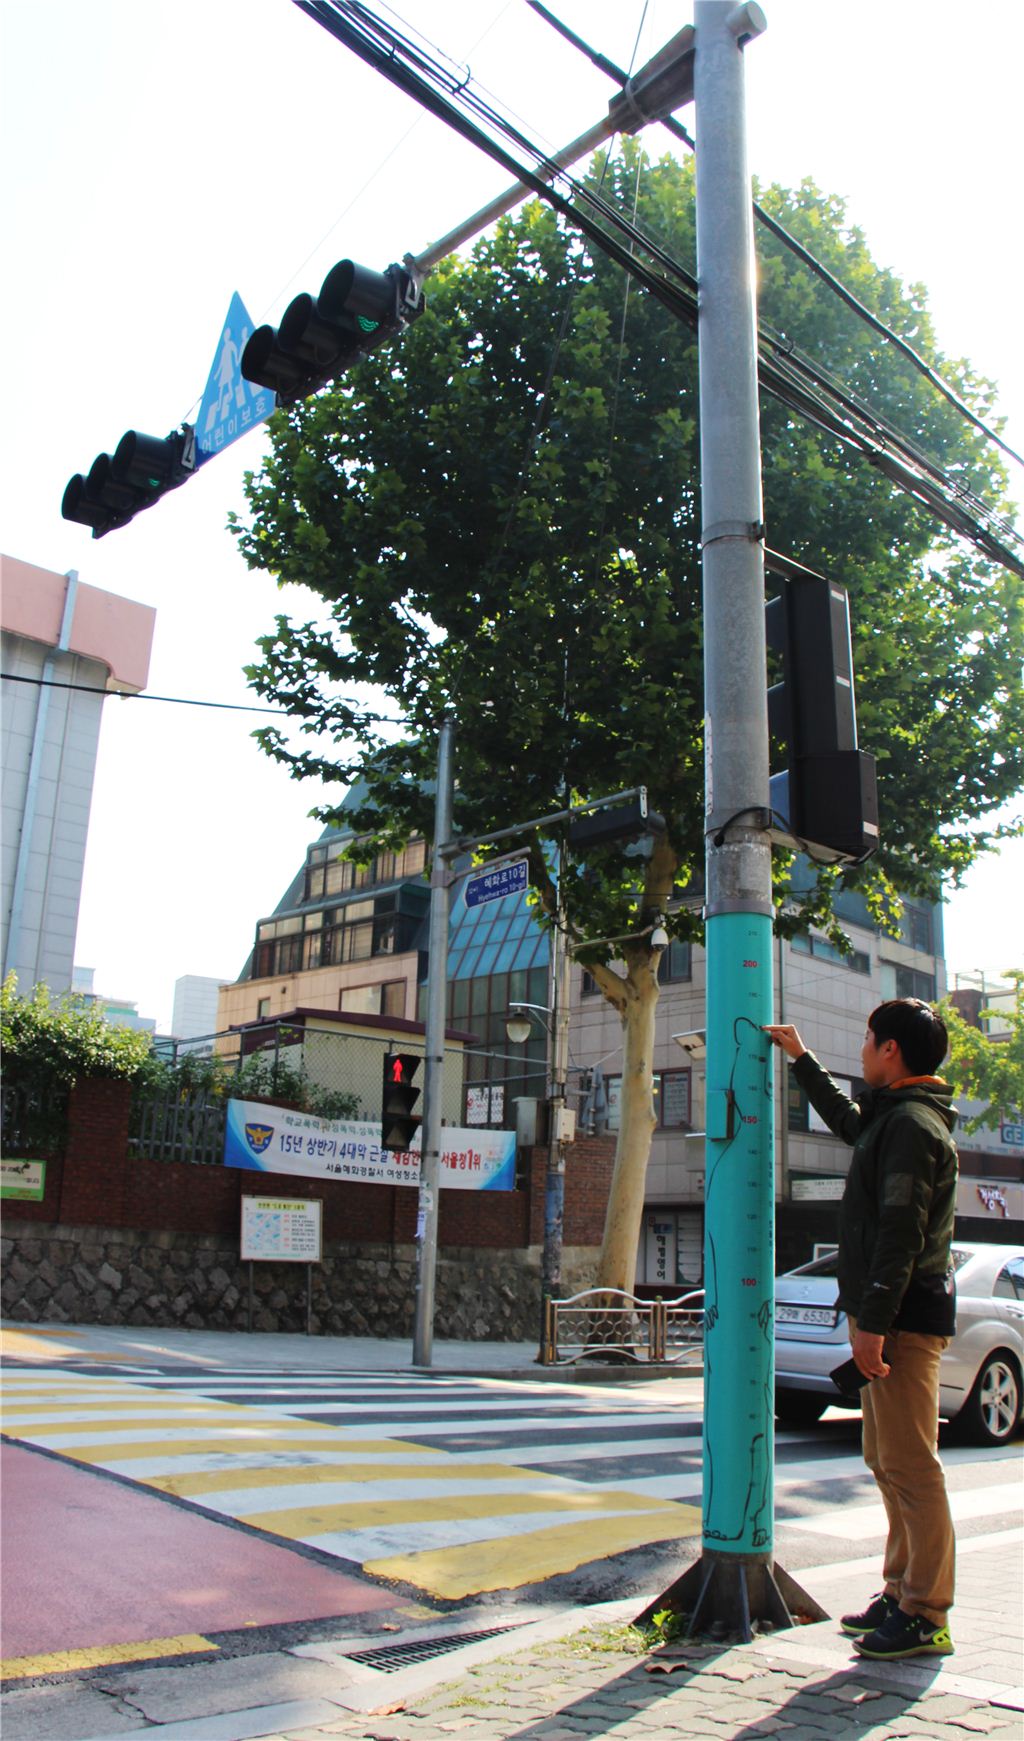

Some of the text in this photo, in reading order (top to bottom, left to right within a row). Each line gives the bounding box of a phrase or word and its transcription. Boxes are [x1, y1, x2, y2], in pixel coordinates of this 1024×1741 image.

[202, 396, 267, 455] 어린이보호
[484, 864, 526, 888] 혜화로10길
[742, 959, 758, 969] 200
[742, 1115, 758, 1124] 150
[280, 1134, 303, 1154] 15년
[306, 1138, 337, 1158] 상반기
[339, 1142, 367, 1161] 4대악
[325, 1163, 422, 1181] 서울혜화경찰서 여성청소
[741, 1278, 757, 1287] 100
